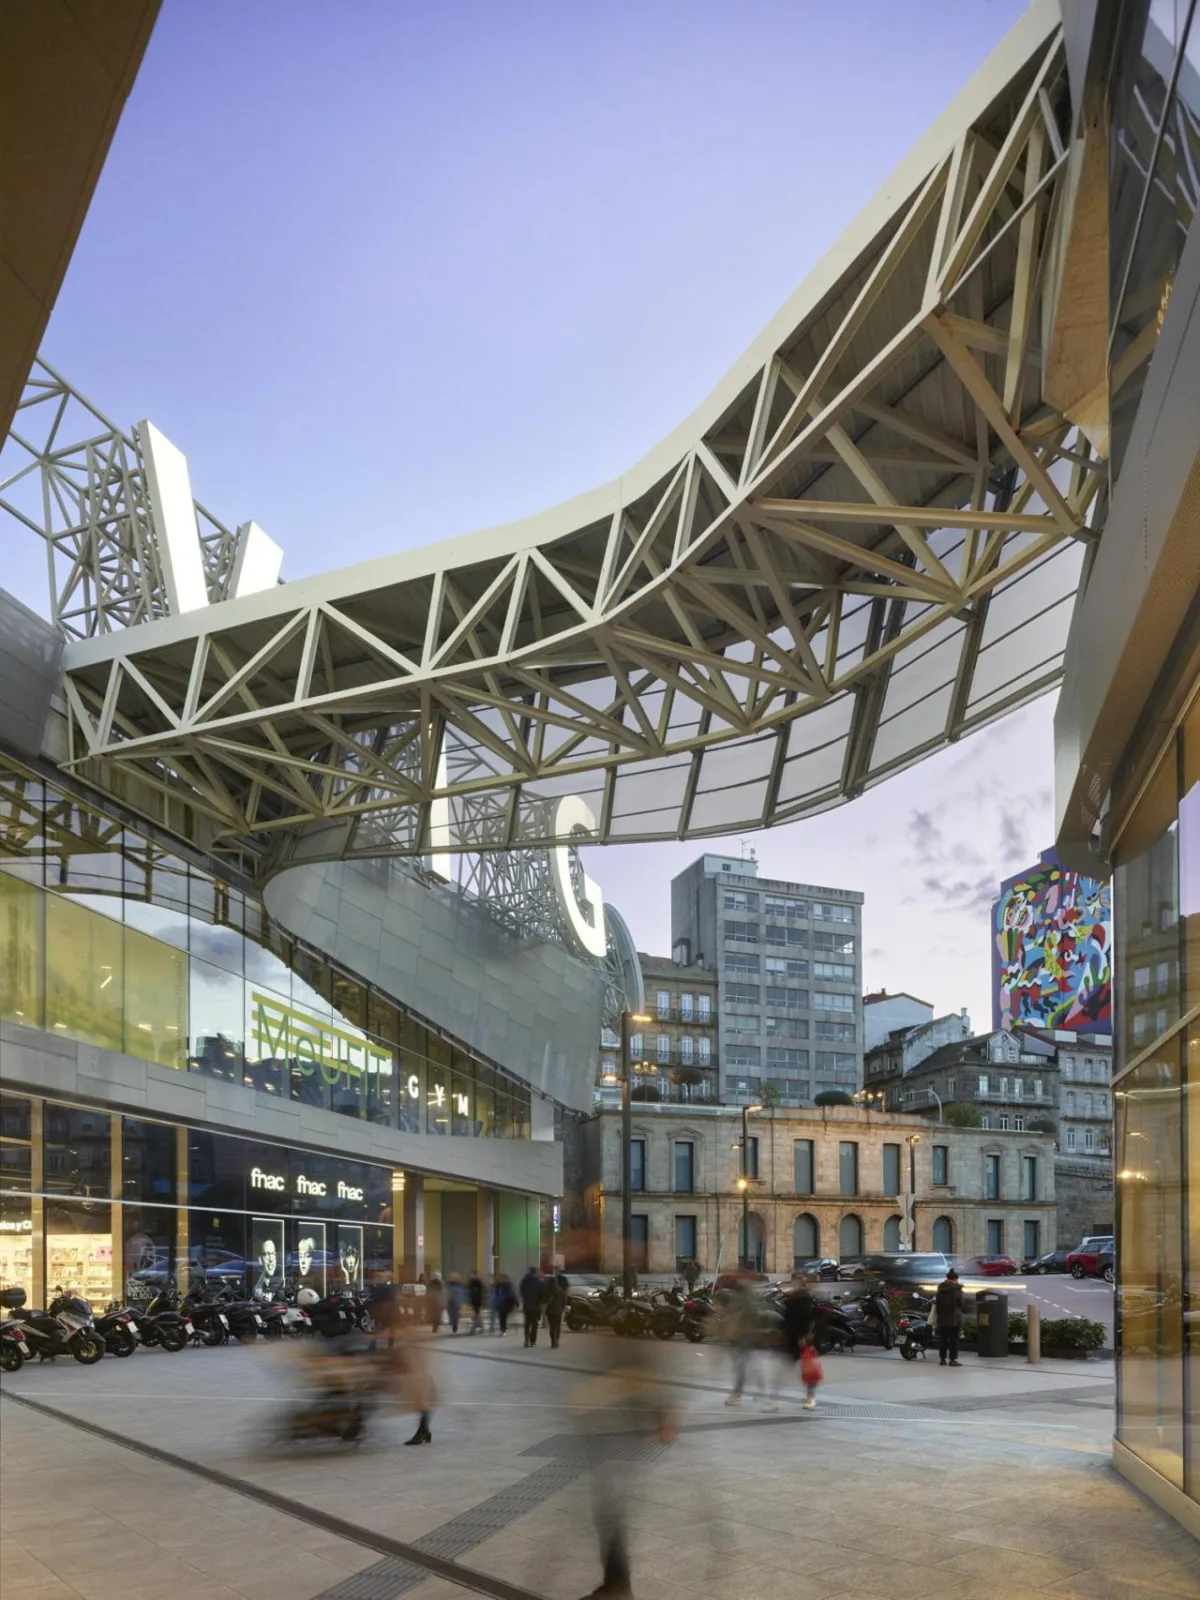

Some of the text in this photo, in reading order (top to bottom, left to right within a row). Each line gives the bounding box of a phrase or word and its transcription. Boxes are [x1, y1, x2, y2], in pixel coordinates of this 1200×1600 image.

[408, 1075, 469, 1116] GYM
[250, 1167, 363, 1200] fnac fnac fnac
